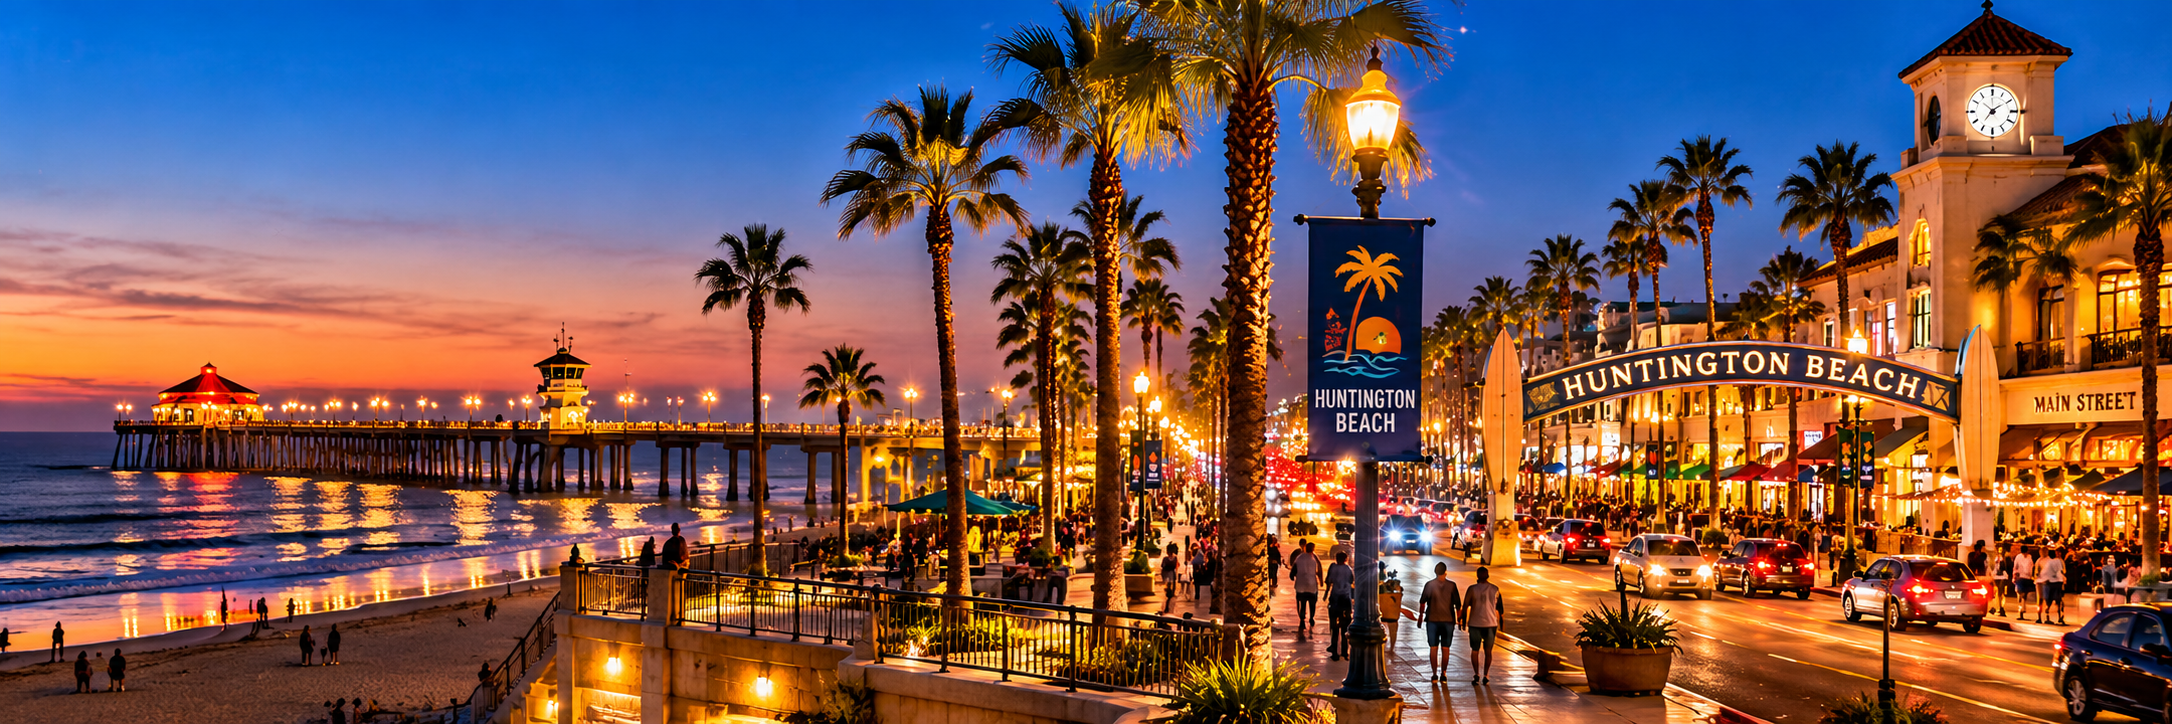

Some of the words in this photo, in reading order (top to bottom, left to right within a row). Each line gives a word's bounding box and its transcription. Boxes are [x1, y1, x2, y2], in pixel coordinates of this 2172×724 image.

[1562, 351, 1791, 400] HUNTINGTON
[1805, 354, 1921, 399] BEACH
[1315, 389, 1416, 409] HUNTINGTON
[2034, 393, 2071, 413] MAIN
[2076, 391, 2136, 412] STREET
[1336, 412, 1396, 433] BEACH
